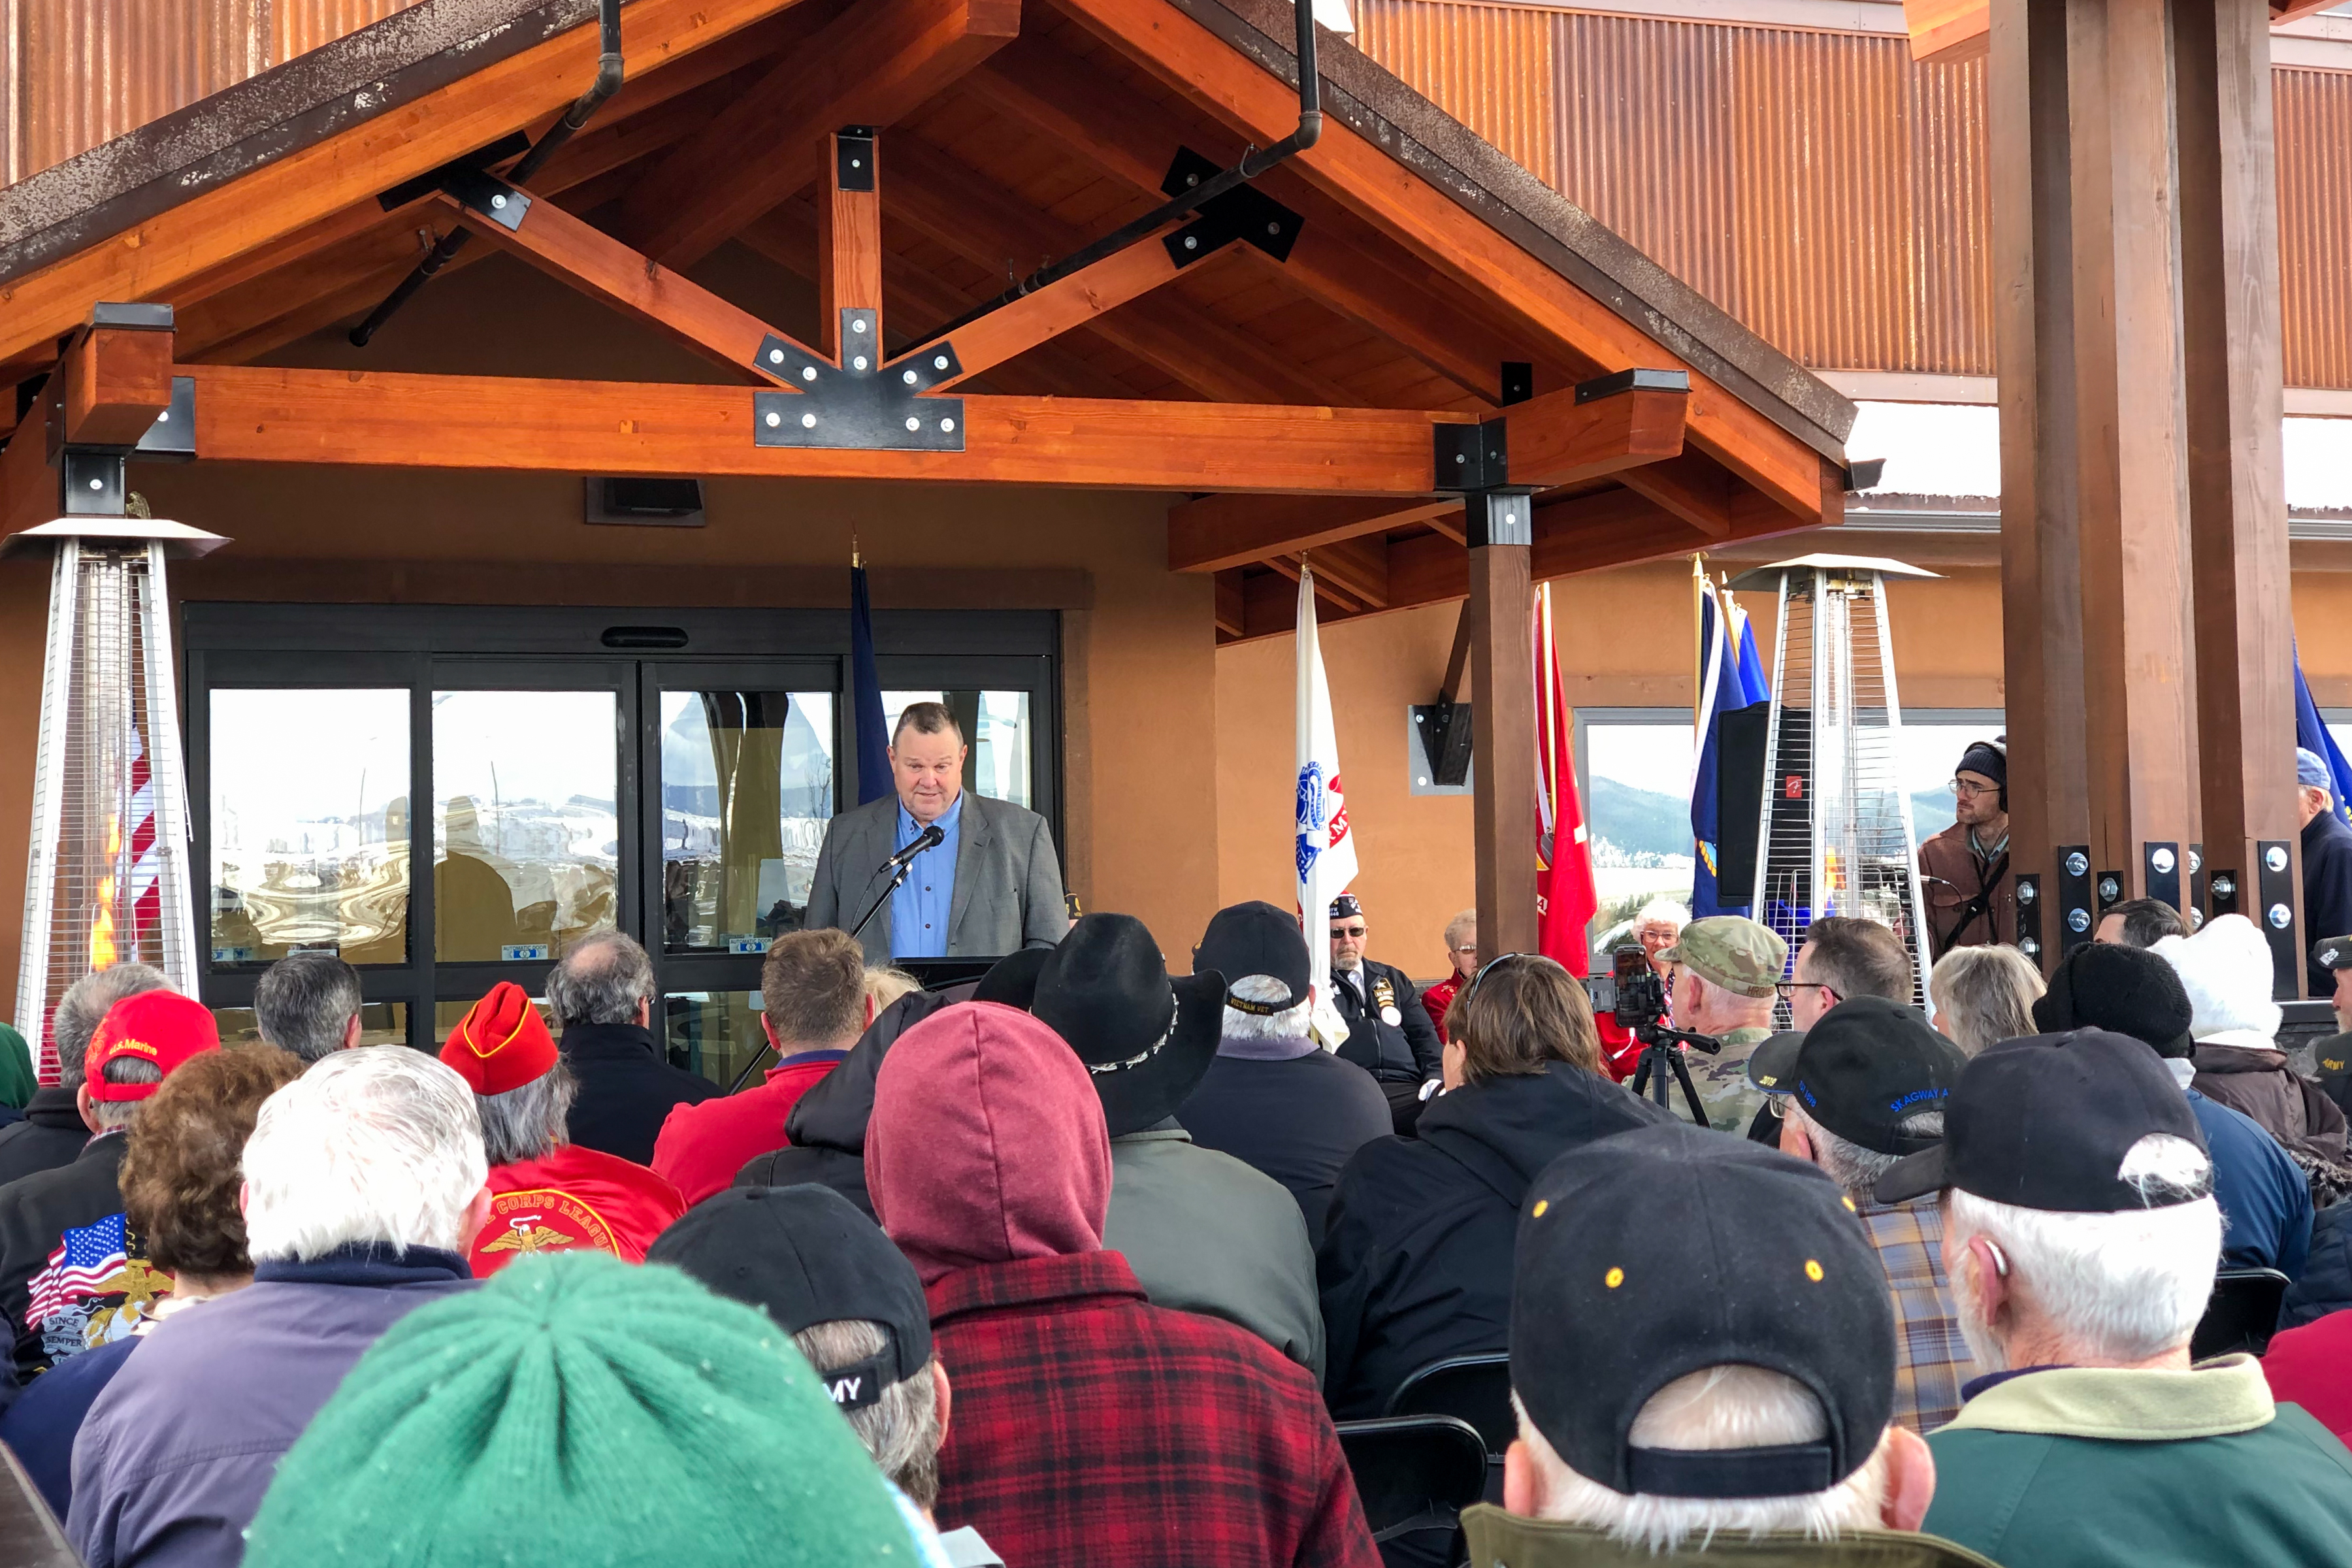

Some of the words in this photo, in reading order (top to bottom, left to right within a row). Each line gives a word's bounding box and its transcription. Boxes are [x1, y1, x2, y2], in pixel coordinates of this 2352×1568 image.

[1231, 997, 1256, 1011] VIETNAM
[124, 1038, 157, 1056] Marine
[2322, 1058, 2345, 1071] ARMY
[1759, 1075, 1778, 1086] 2019
[1890, 1087, 1939, 1113] SKAGWAY
[497, 1194, 555, 1215] CORPS
[48, 1316, 80, 1328] SINCE
[46, 1335, 82, 1347] SEMPER
